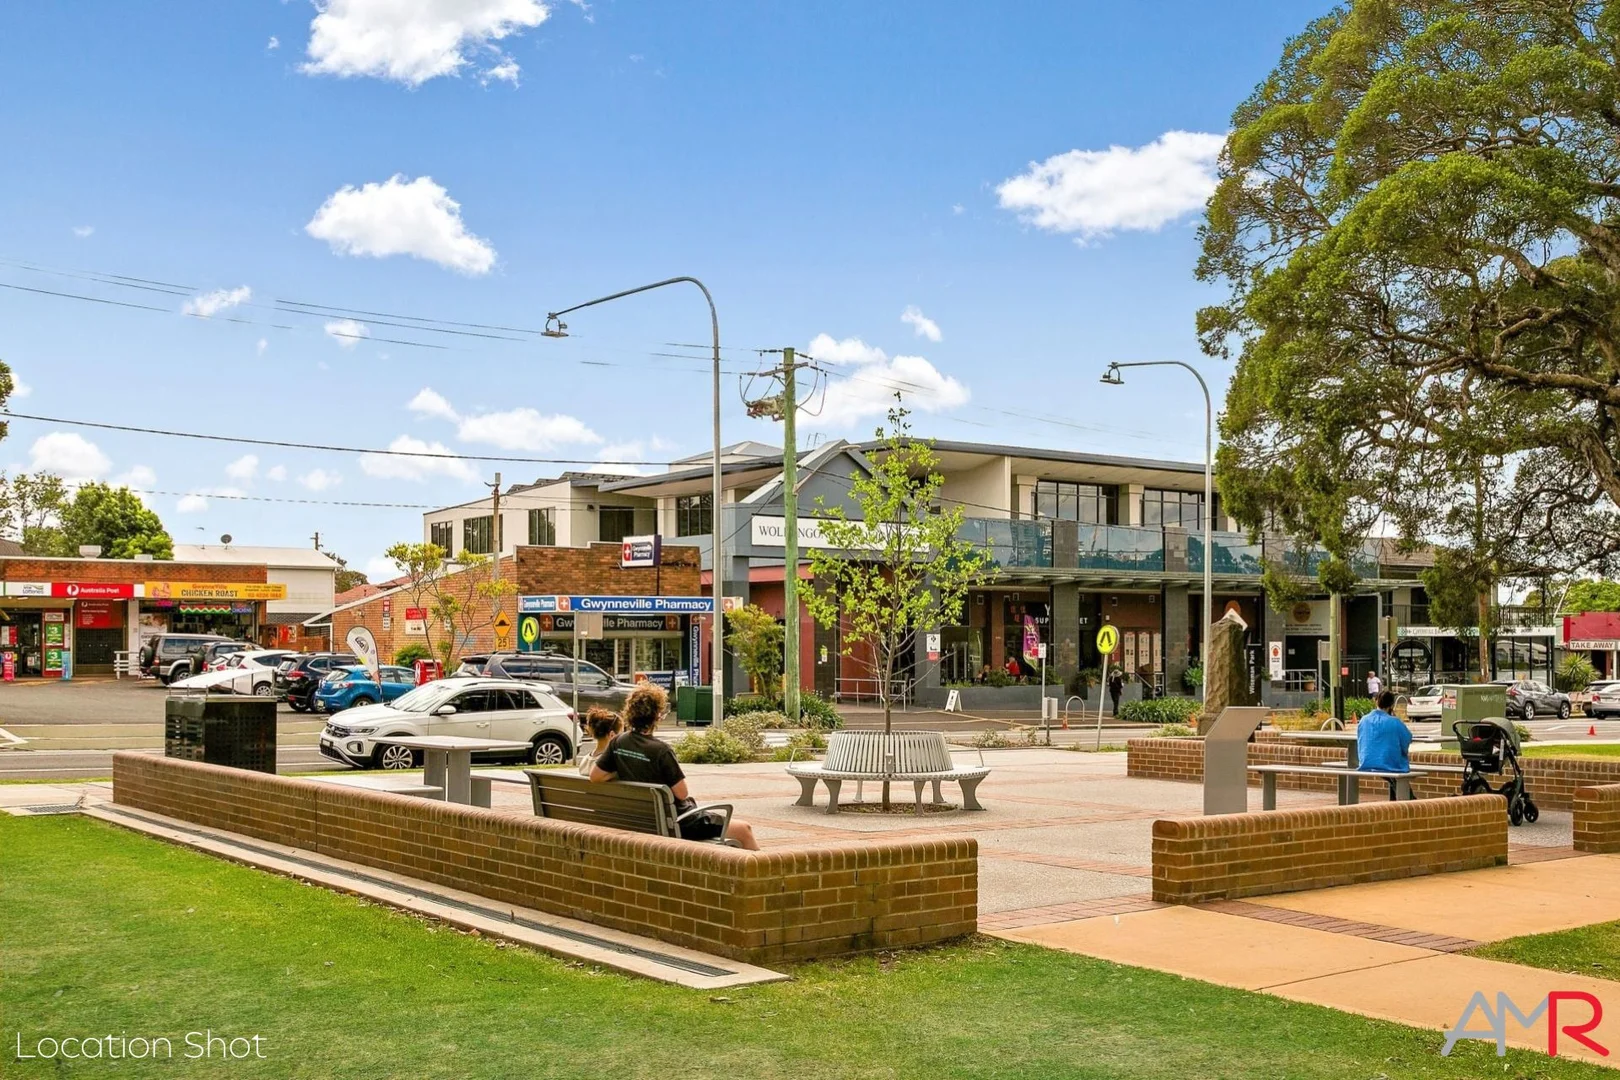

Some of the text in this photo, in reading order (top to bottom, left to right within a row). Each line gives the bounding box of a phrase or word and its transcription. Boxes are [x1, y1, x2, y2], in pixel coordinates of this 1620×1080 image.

[181, 589, 213, 597] CHICKEN
[215, 590, 238, 598] ROAST
[581, 598, 712, 611] Gwynneville Pharmacy
[617, 617, 663, 630] Pharmacy
[498, 638, 507, 648] 25
[1593, 642, 1613, 650] AWAY
